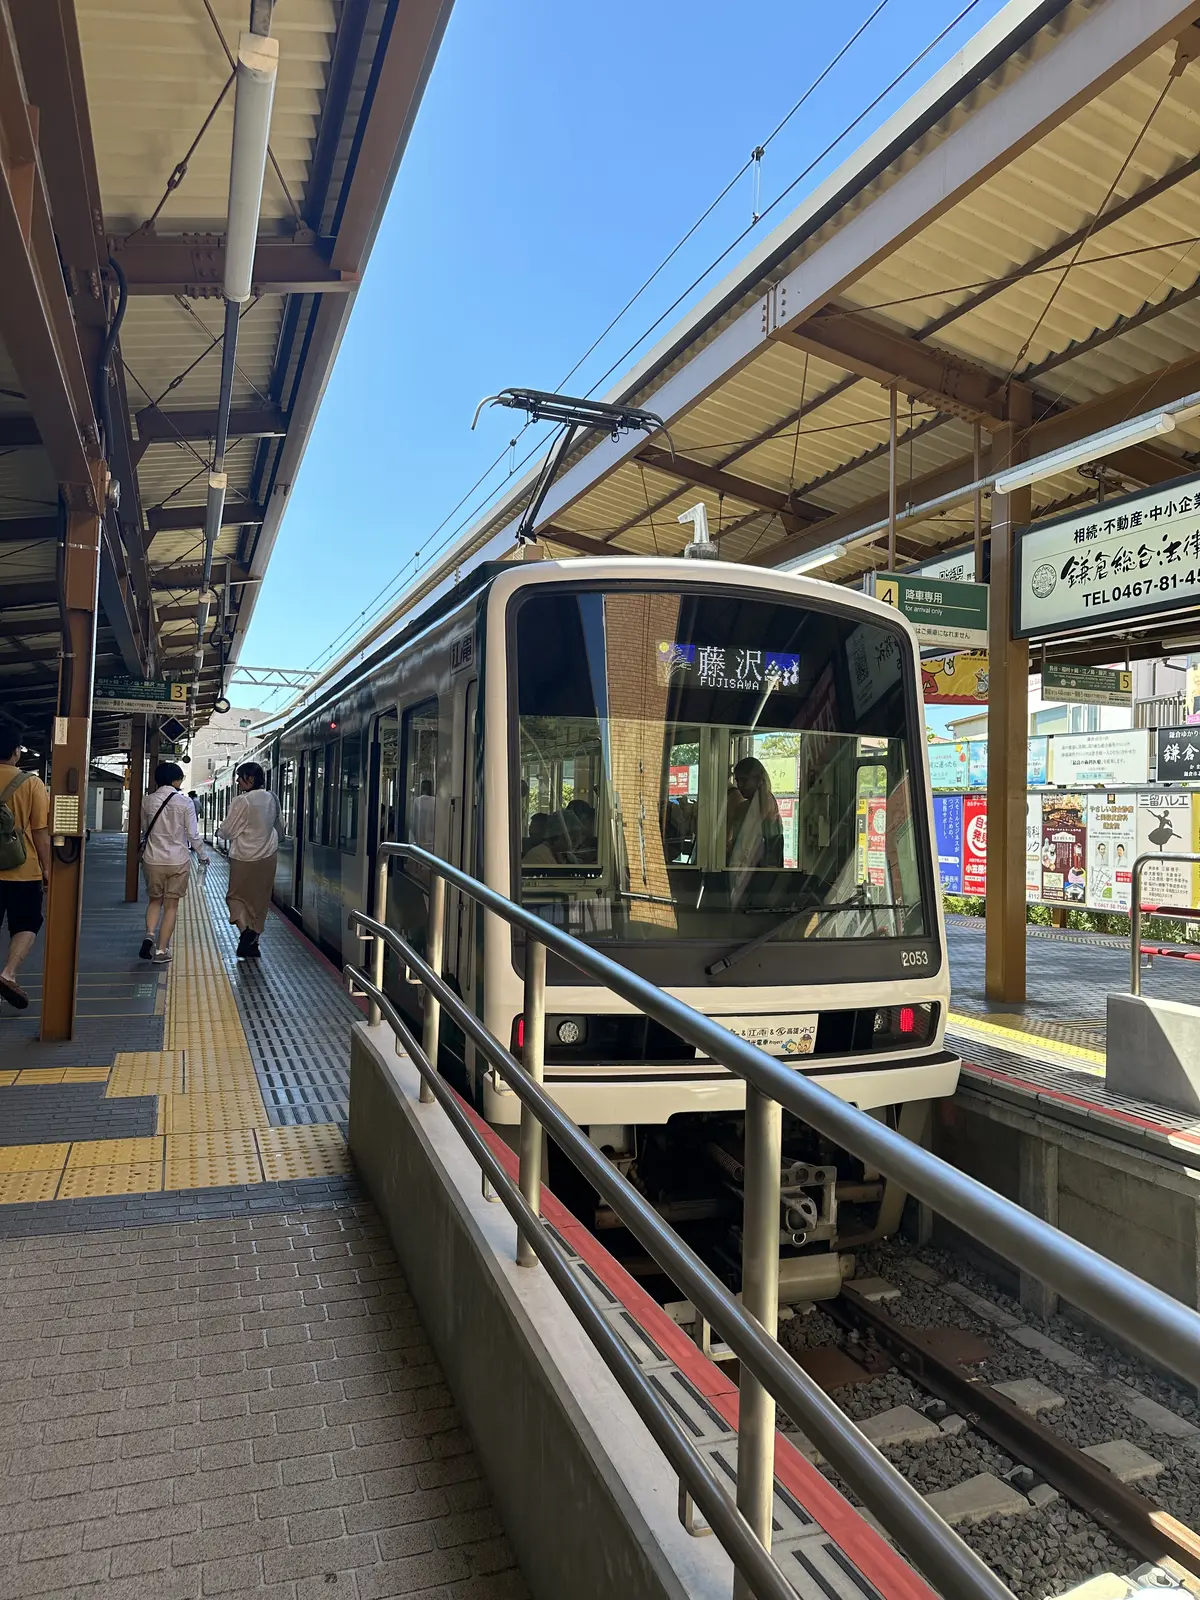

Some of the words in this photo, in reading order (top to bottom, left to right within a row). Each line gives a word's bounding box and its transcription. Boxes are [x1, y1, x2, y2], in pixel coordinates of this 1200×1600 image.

[881, 588, 894, 606] 4
[905, 588, 943, 604] 降車専用
[904, 604, 914, 612] for
[931, 608, 943, 616] only
[697, 645, 762, 681] 藤沢
[700, 676, 760, 691] FUJISAWA
[1122, 674, 1130, 689] 5
[174, 685, 183, 698] 3
[1168, 730, 1200, 739] 鎌倉ゆかり
[901, 950, 929, 966] 2053
